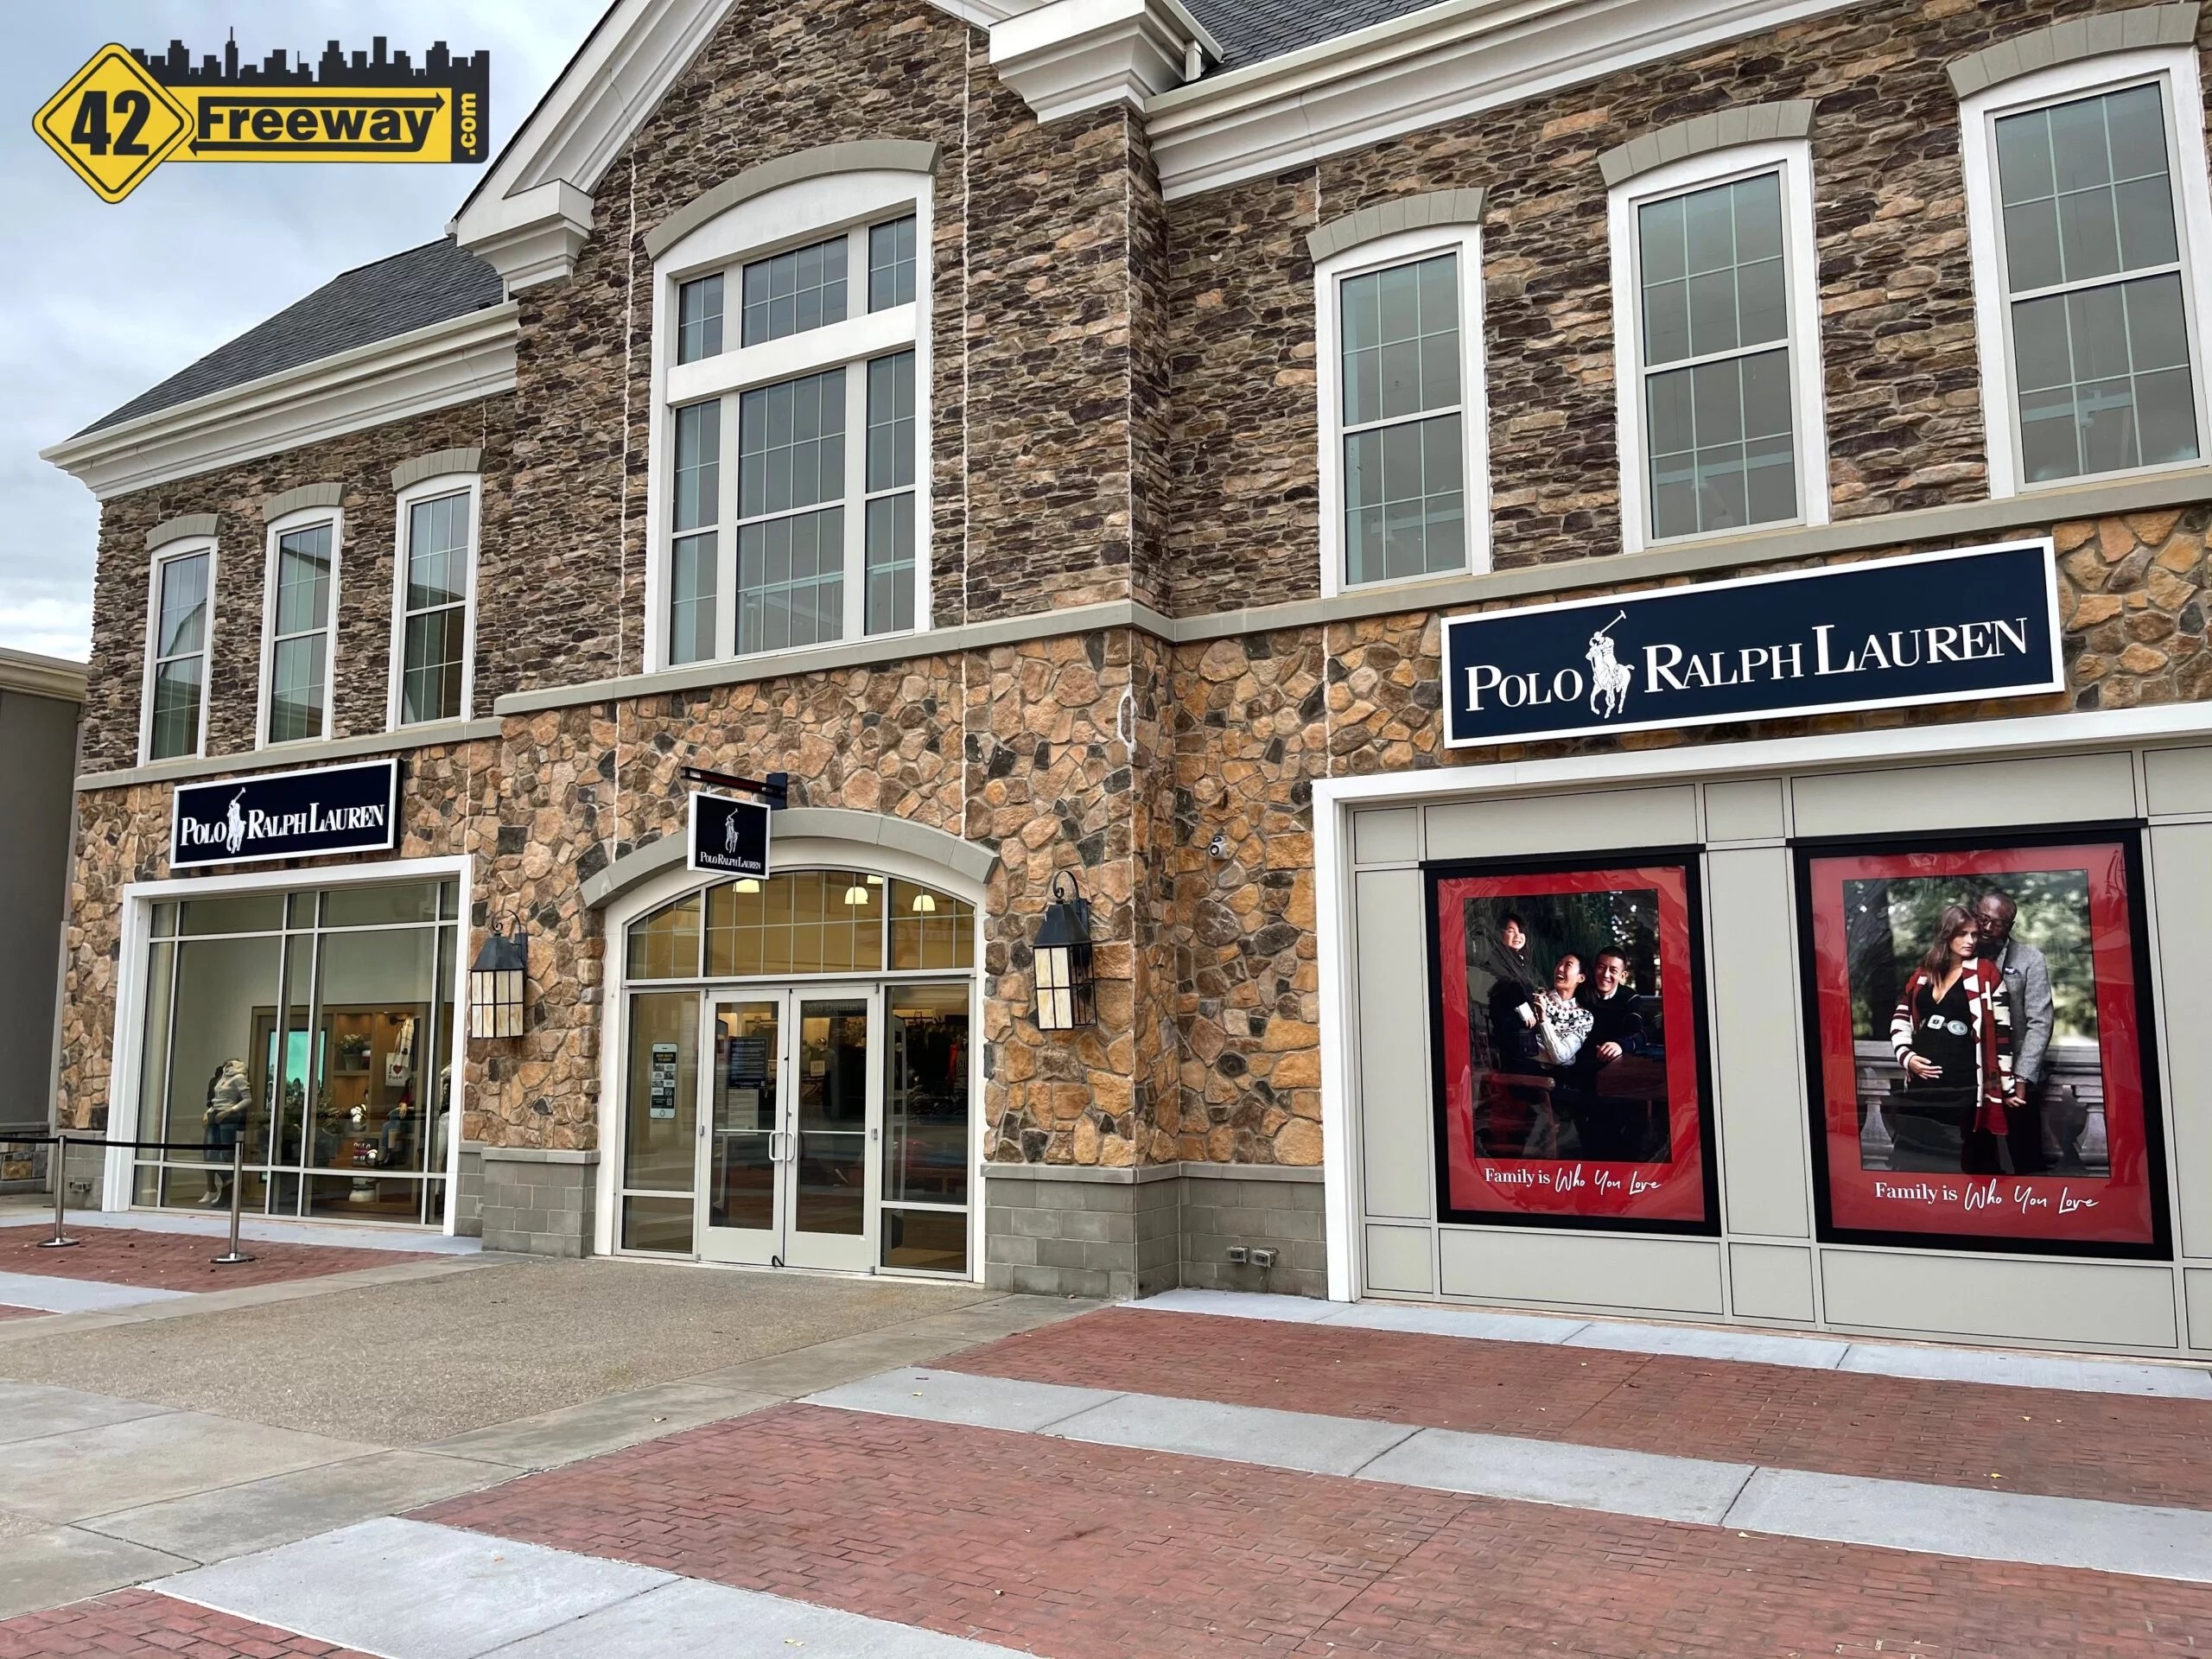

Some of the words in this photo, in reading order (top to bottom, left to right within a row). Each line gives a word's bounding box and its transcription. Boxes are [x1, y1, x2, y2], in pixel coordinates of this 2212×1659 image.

[1465, 664, 1583, 712] POLO
[1643, 644, 1805, 693] RALPH
[1812, 617, 2028, 676] LAUREN
[180, 817, 226, 846] POLO
[247, 809, 307, 840] RALPH
[308, 802, 385, 833] LAUREN
[700, 851, 717, 864] POLO
[718, 854, 738, 867] RALPH
[738, 856, 761, 869] LAUREN
[1484, 1167, 1535, 1188] Family
[1538, 1169, 1551, 1185] is
[1555, 1163, 1586, 1192] Who
[1594, 1169, 1621, 1195] You
[1629, 1171, 1662, 1195] Love
[1874, 1181, 1937, 1205] Family
[1942, 1184, 1958, 1201] is
[1964, 1178, 2003, 1211] Who
[2014, 1185, 2047, 1214] You
[2058, 1186, 2100, 1214] Love
